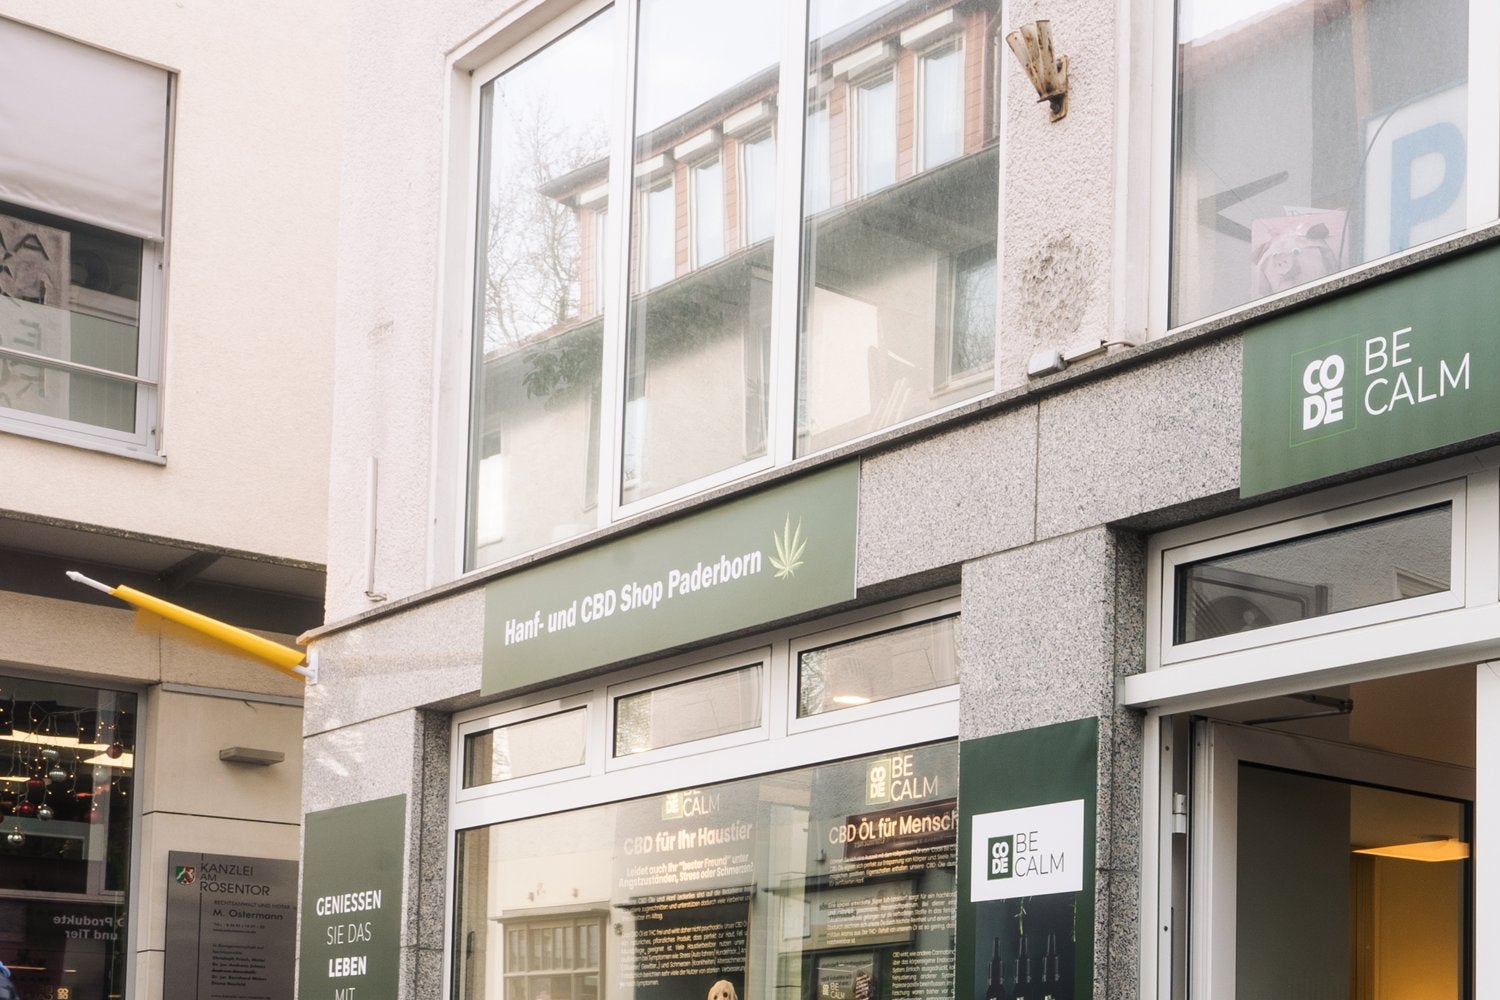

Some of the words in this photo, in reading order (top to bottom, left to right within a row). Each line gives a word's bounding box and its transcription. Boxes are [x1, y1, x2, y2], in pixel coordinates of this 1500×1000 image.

[1365, 327, 1412, 376] BE
[1364, 352, 1470, 415] CALM
[504, 610, 544, 646] Hanf-
[548, 600, 577, 633] und
[581, 589, 617, 623] CBD
[620, 580, 663, 613] Shop
[668, 550, 762, 599] Paderborn
[892, 755, 913, 779] BE
[891, 775, 938, 801] CALM
[683, 793, 720, 817] CALM
[624, 836, 652, 855] CBD
[655, 832, 676, 852] für
[678, 829, 696, 850] Ihr
[698, 820, 753, 847] Haustier
[829, 824, 856, 844] CBD
[879, 817, 897, 838] für
[1016, 831, 1038, 853] BE
[201, 862, 254, 876] KANZLEI
[649, 863, 667, 875] auch
[701, 868, 716, 878] oder
[1015, 852, 1064, 877] CALM
[200, 873, 217, 881] AM
[200, 881, 270, 896] ROSENTOR
[212, 909, 225, 917] M.
[228, 909, 283, 921] Ostermann
[316, 890, 381, 916] GENIESSEN
[327, 925, 344, 945] SIE
[347, 922, 371, 943] DAS
[329, 956, 367, 978] LEBEN
